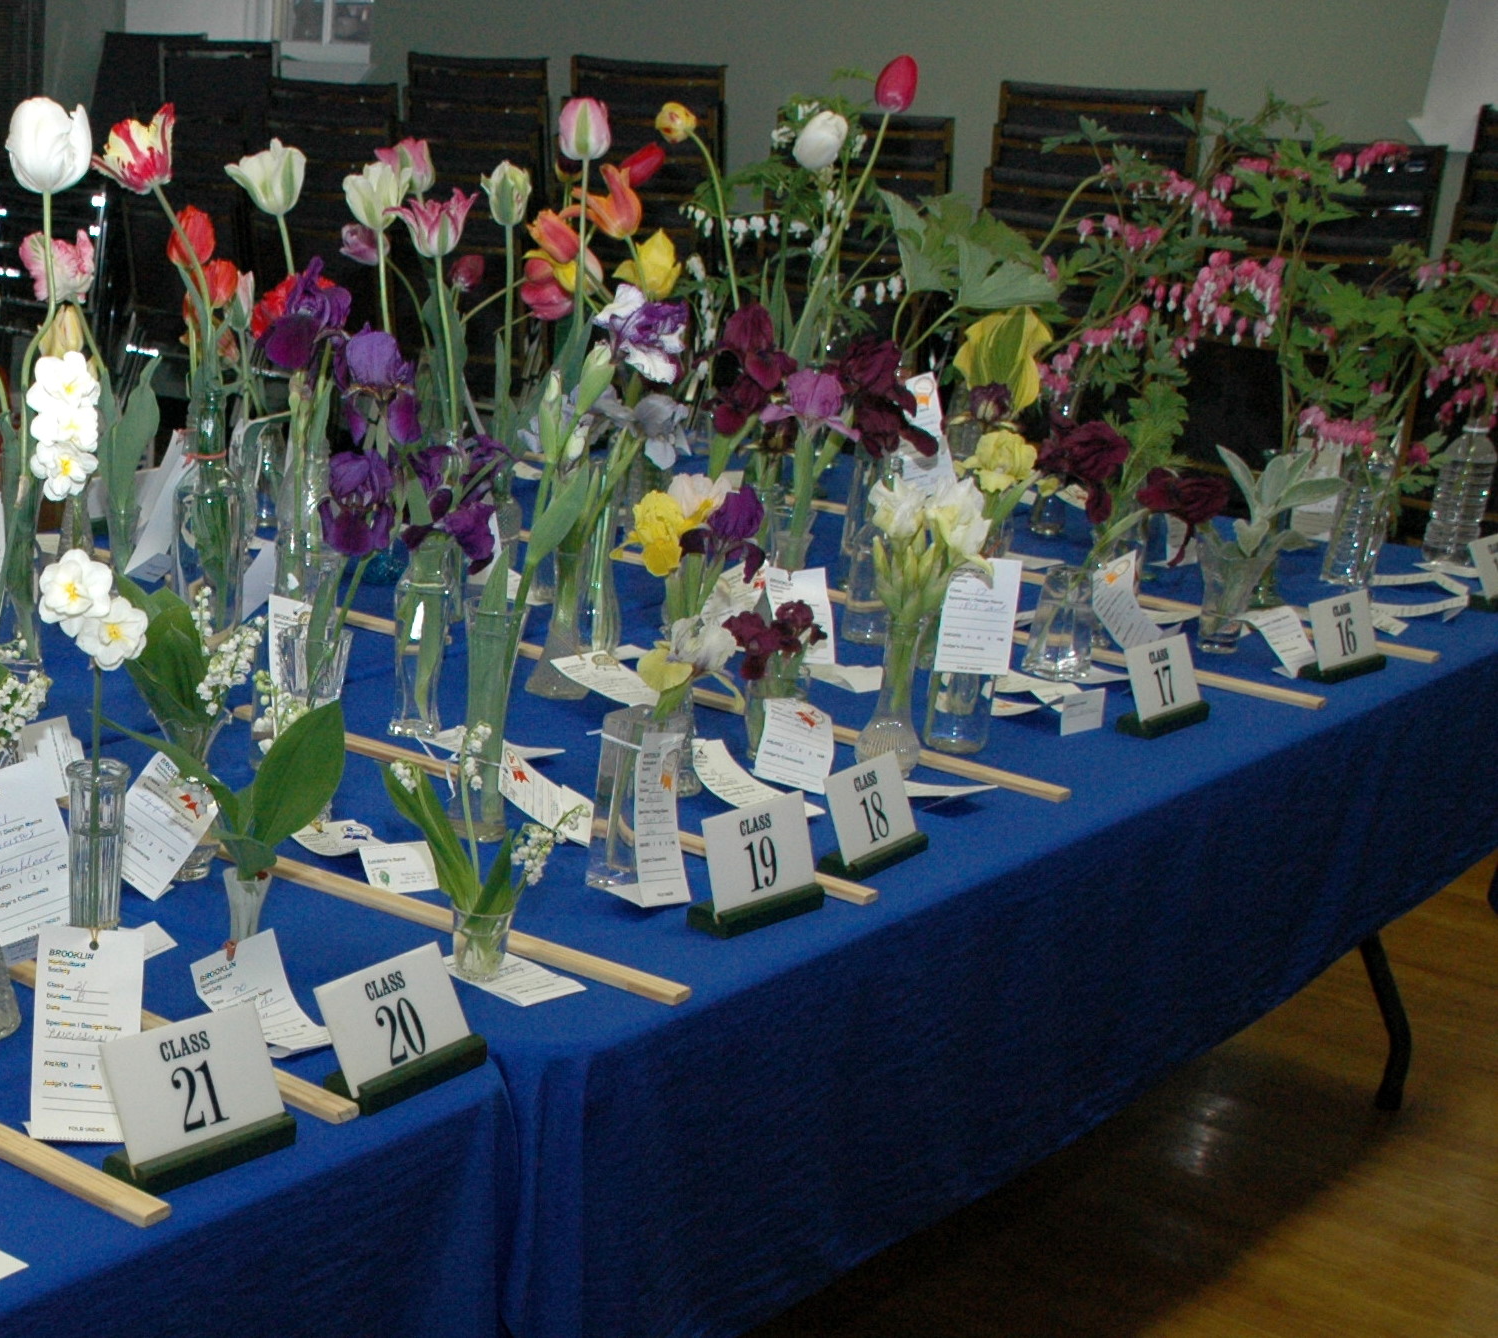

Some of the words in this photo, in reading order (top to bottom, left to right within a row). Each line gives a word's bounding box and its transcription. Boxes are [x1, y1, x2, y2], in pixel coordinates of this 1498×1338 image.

[1331, 601, 1352, 618] CLASS
[1335, 617, 1358, 658] 16
[1148, 647, 1169, 665] CLASS
[1153, 665, 1175, 707] 17
[853, 770, 878, 793] CLASS
[739, 812, 772, 837] CLASS
[859, 791, 890, 844] 18
[743, 835, 778, 893] 19
[49, 949, 94, 960] BROOKLIN
[199, 960, 237, 982] BROOKLIN
[364, 969, 406, 1002] CLASS
[46, 1019, 76, 1028] Specimen
[375, 997, 426, 1067] 20
[159, 1030, 211, 1062] CLASS
[171, 1060, 230, 1133] 21
